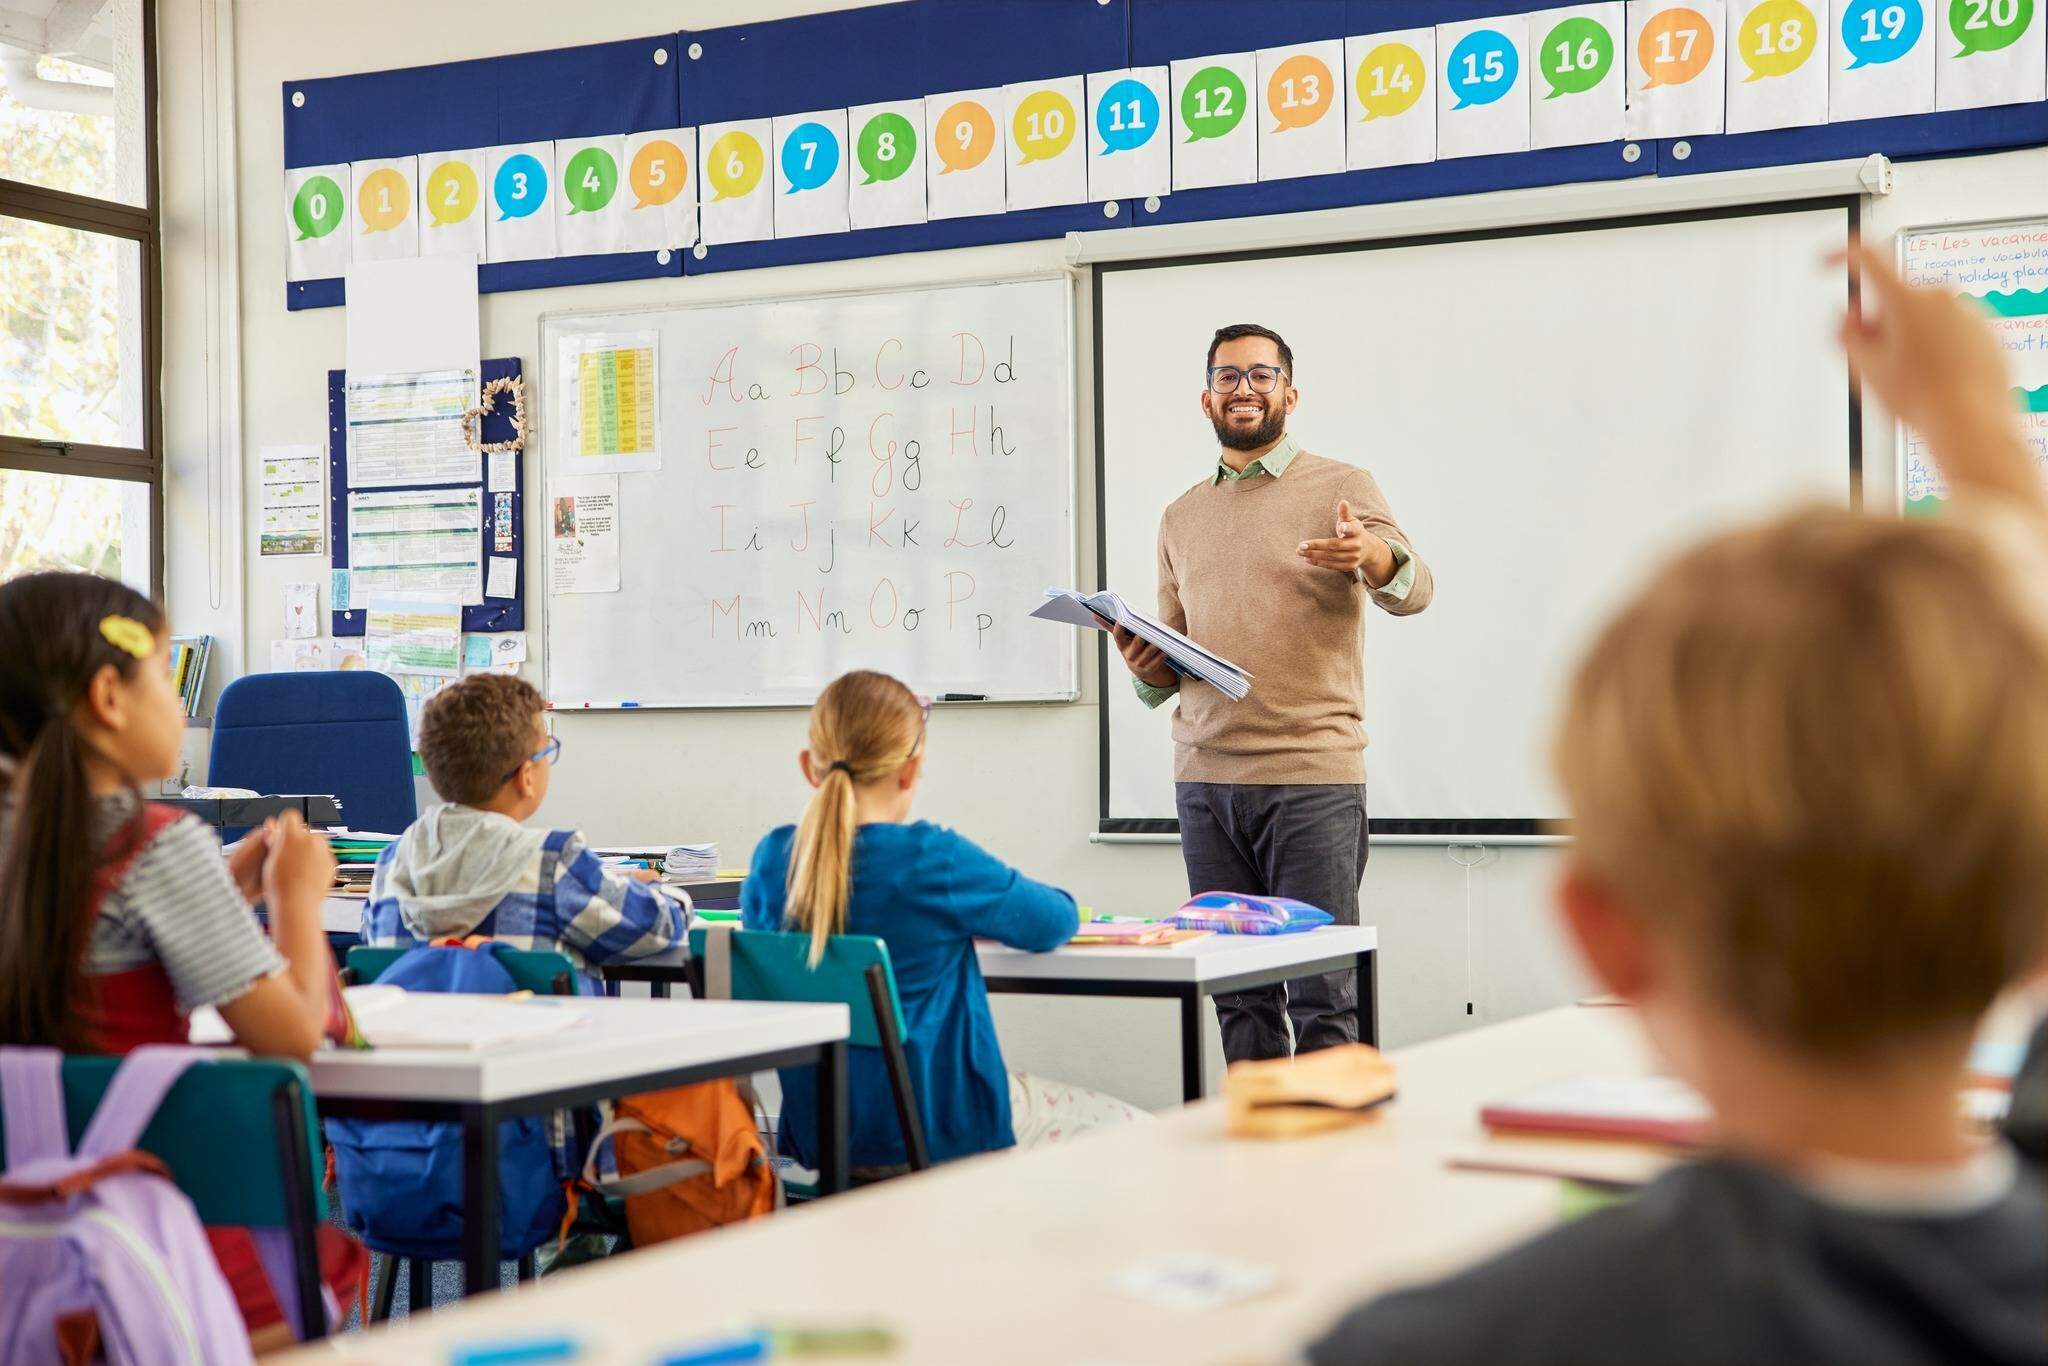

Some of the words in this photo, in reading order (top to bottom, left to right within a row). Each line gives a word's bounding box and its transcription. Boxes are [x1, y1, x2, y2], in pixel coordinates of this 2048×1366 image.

[308, 193, 327, 220] 0
[378, 187, 393, 214] 1
[445, 179, 460, 207] 2
[512, 172, 528, 199] 3
[582, 167, 600, 192] 4
[650, 160, 665, 186] 5
[727, 151, 743, 179] 6
[801, 143, 816, 169] 7
[877, 132, 896, 161] 8
[956, 122, 973, 150] 9
[1028, 109, 1064, 140] 10
[1111, 100, 1144, 130] 11
[1194, 86, 1232, 118] 12
[1282, 75, 1319, 108] 13
[1371, 64, 1411, 96] 14
[1464, 51, 1503, 83] 15
[1556, 38, 1599, 73] 16
[1655, 29, 1697, 64] 17
[1756, 19, 1802, 55] 18
[1861, 7, 1905, 41] 19
[1965, 0, 2018, 30] 20
[1943, 236, 1970, 250] Les
[1959, 268, 2008, 288] holiday
